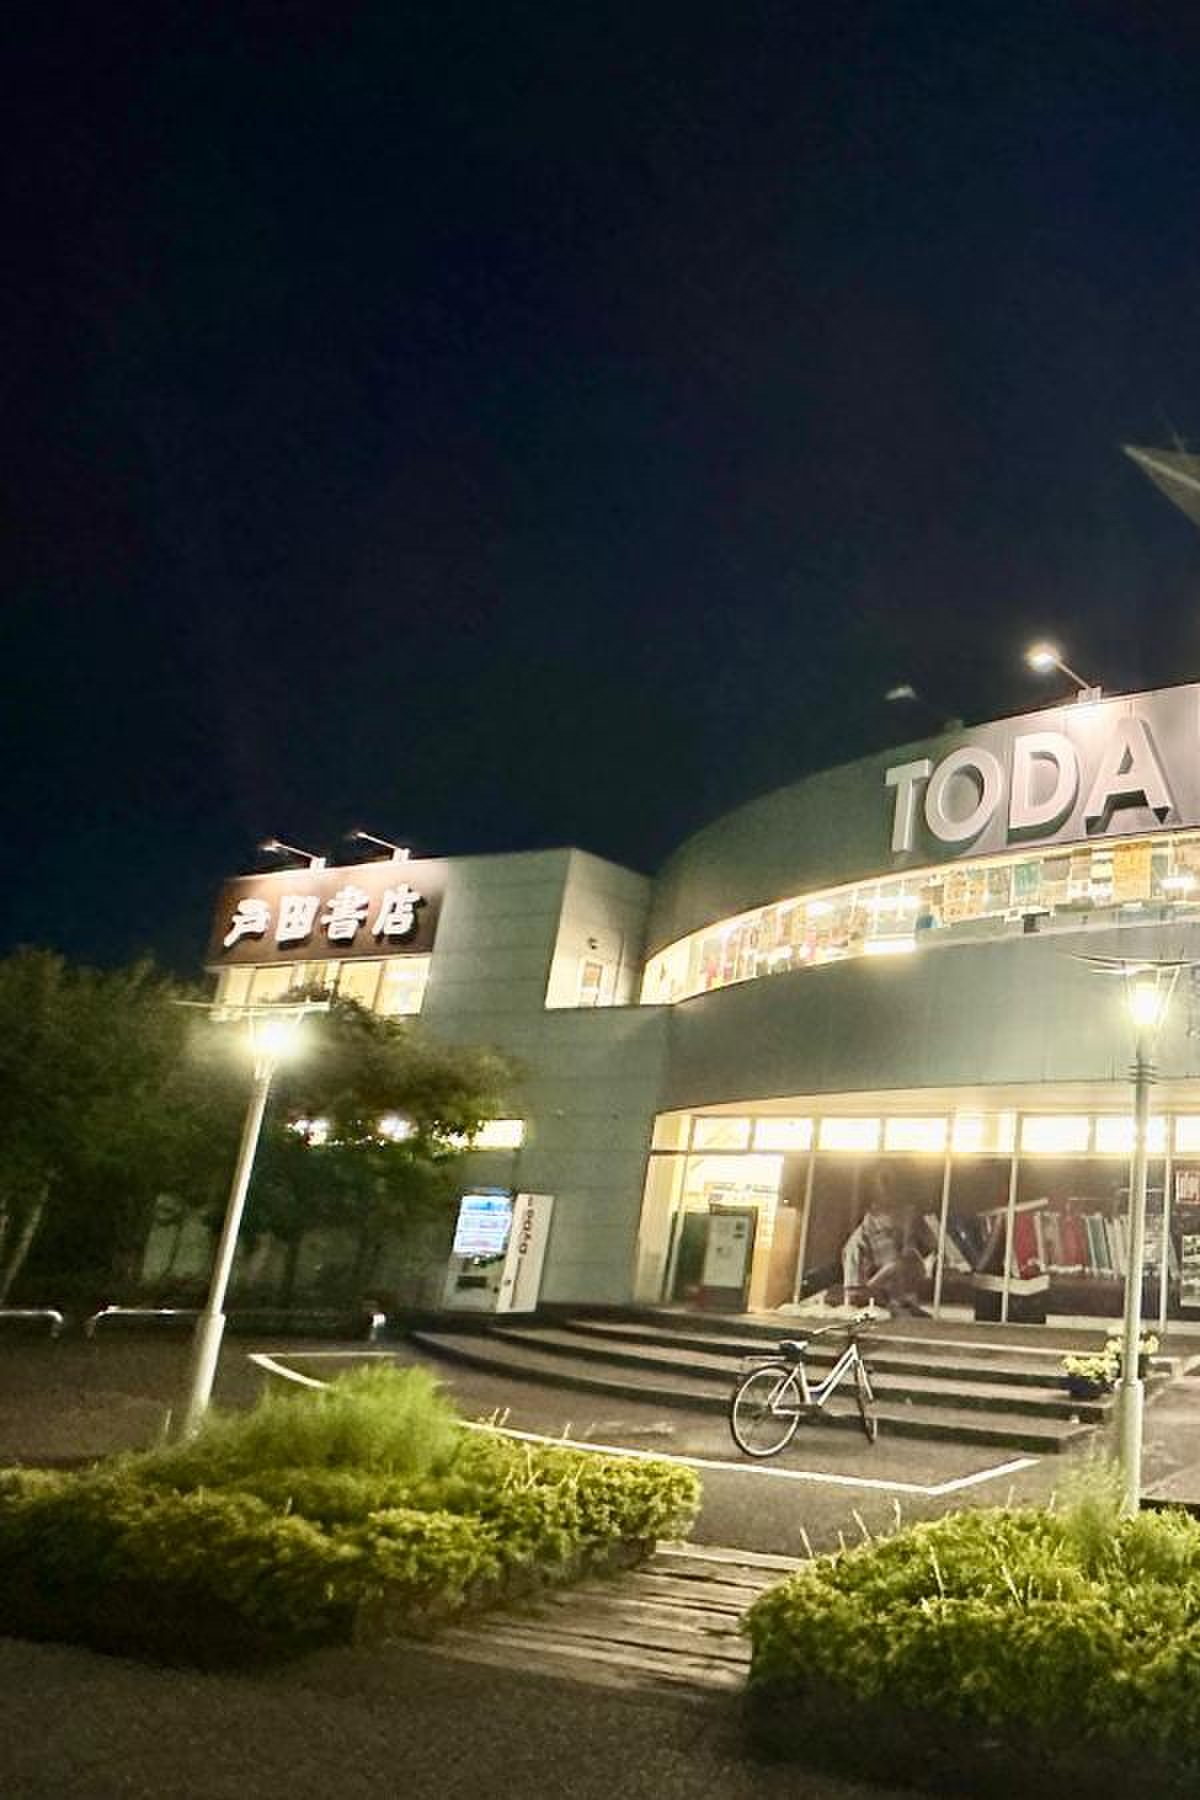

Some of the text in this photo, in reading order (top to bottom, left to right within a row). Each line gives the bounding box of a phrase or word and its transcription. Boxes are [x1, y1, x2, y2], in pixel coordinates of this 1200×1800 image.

[885, 719, 1174, 853] TODA
[223, 883, 423, 948] 戸田書店
